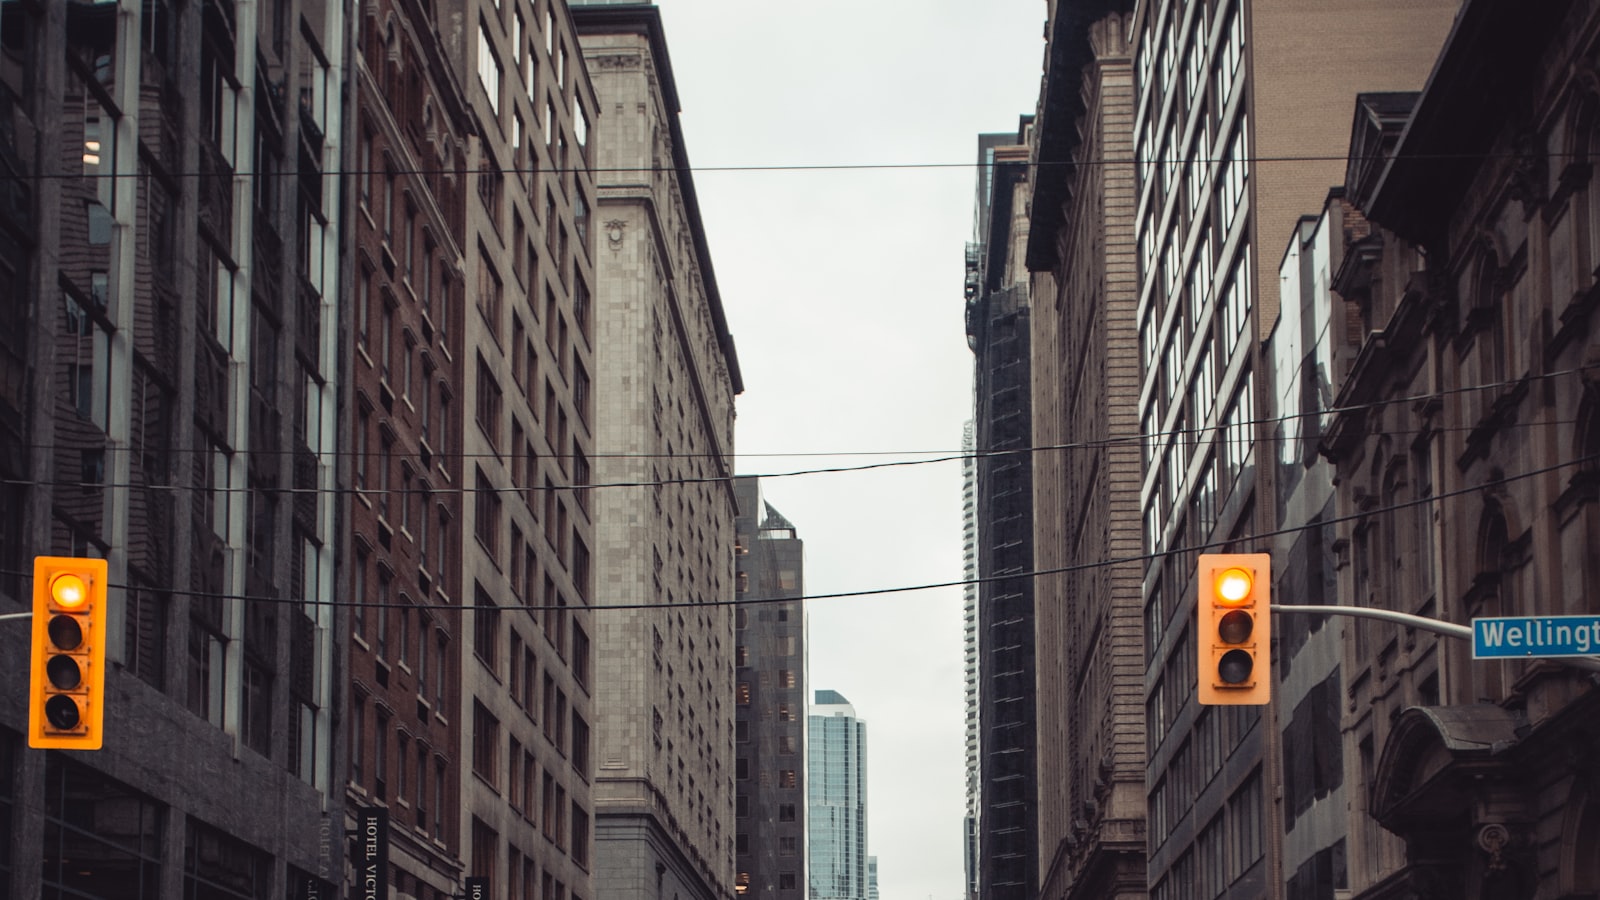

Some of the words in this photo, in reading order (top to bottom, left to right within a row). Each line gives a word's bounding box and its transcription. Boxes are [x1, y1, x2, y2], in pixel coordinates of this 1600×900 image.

[1481, 620, 1600, 652] Wellingt
[366, 817, 377, 861] HOTEL
[473, 885, 481, 900] HO
